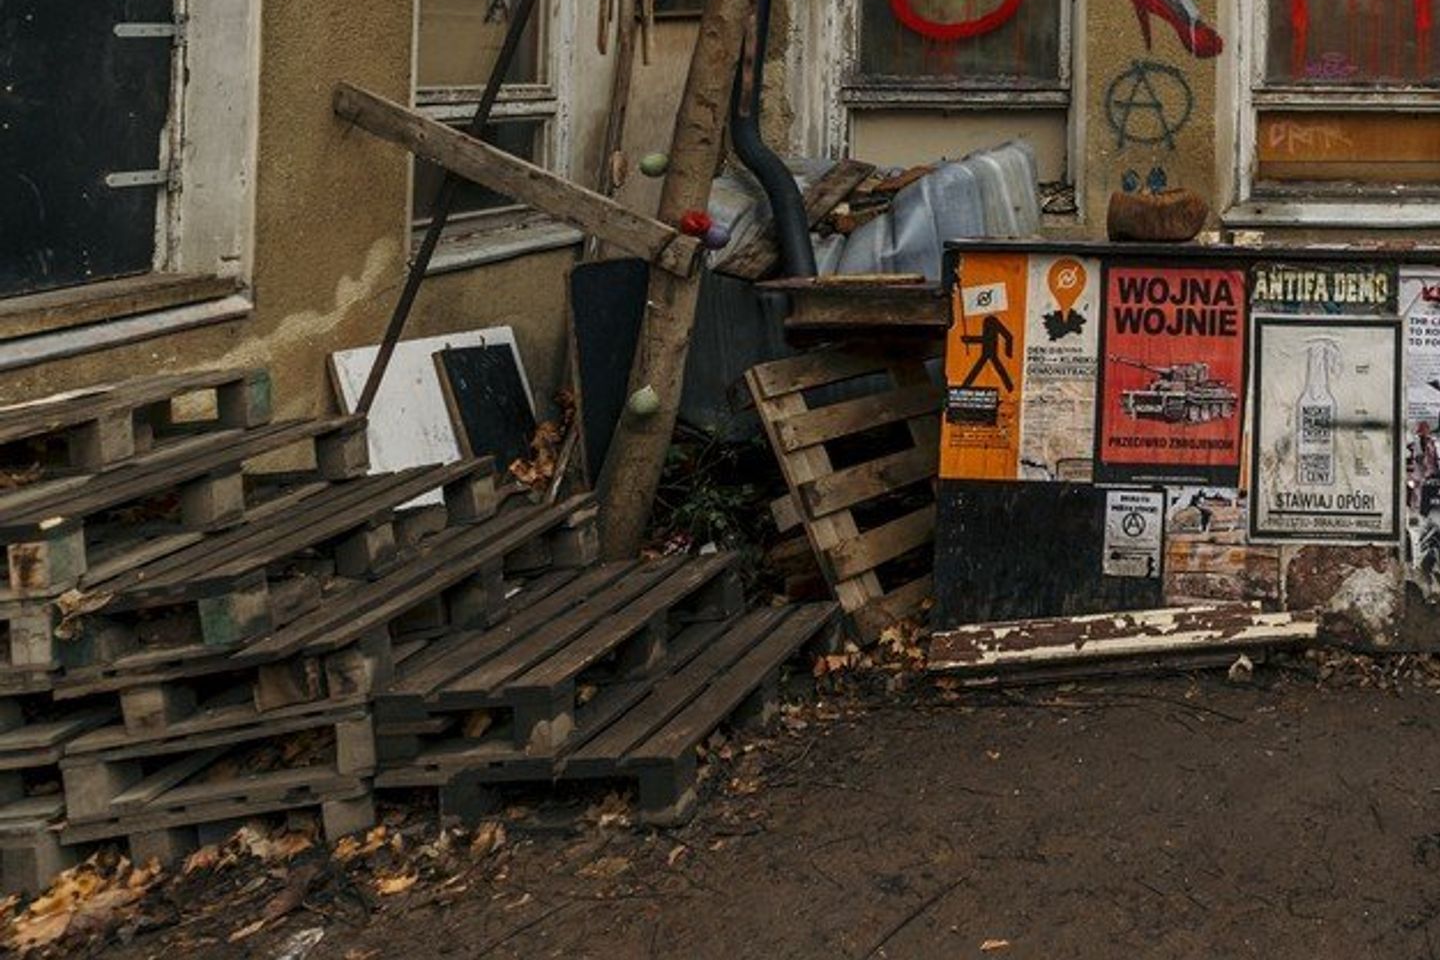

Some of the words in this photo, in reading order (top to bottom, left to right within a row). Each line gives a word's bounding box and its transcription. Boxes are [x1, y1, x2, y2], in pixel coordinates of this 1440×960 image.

[1118, 276, 1235, 307] WOJNA
[1254, 271, 1327, 302] ANTIFA
[1333, 271, 1388, 303] DEMO
[1114, 306, 1237, 337] WOJNIE
[1410, 328, 1423, 337] TO
[1409, 338, 1422, 347] TO
[1275, 492, 1333, 509] STAWIAJ
